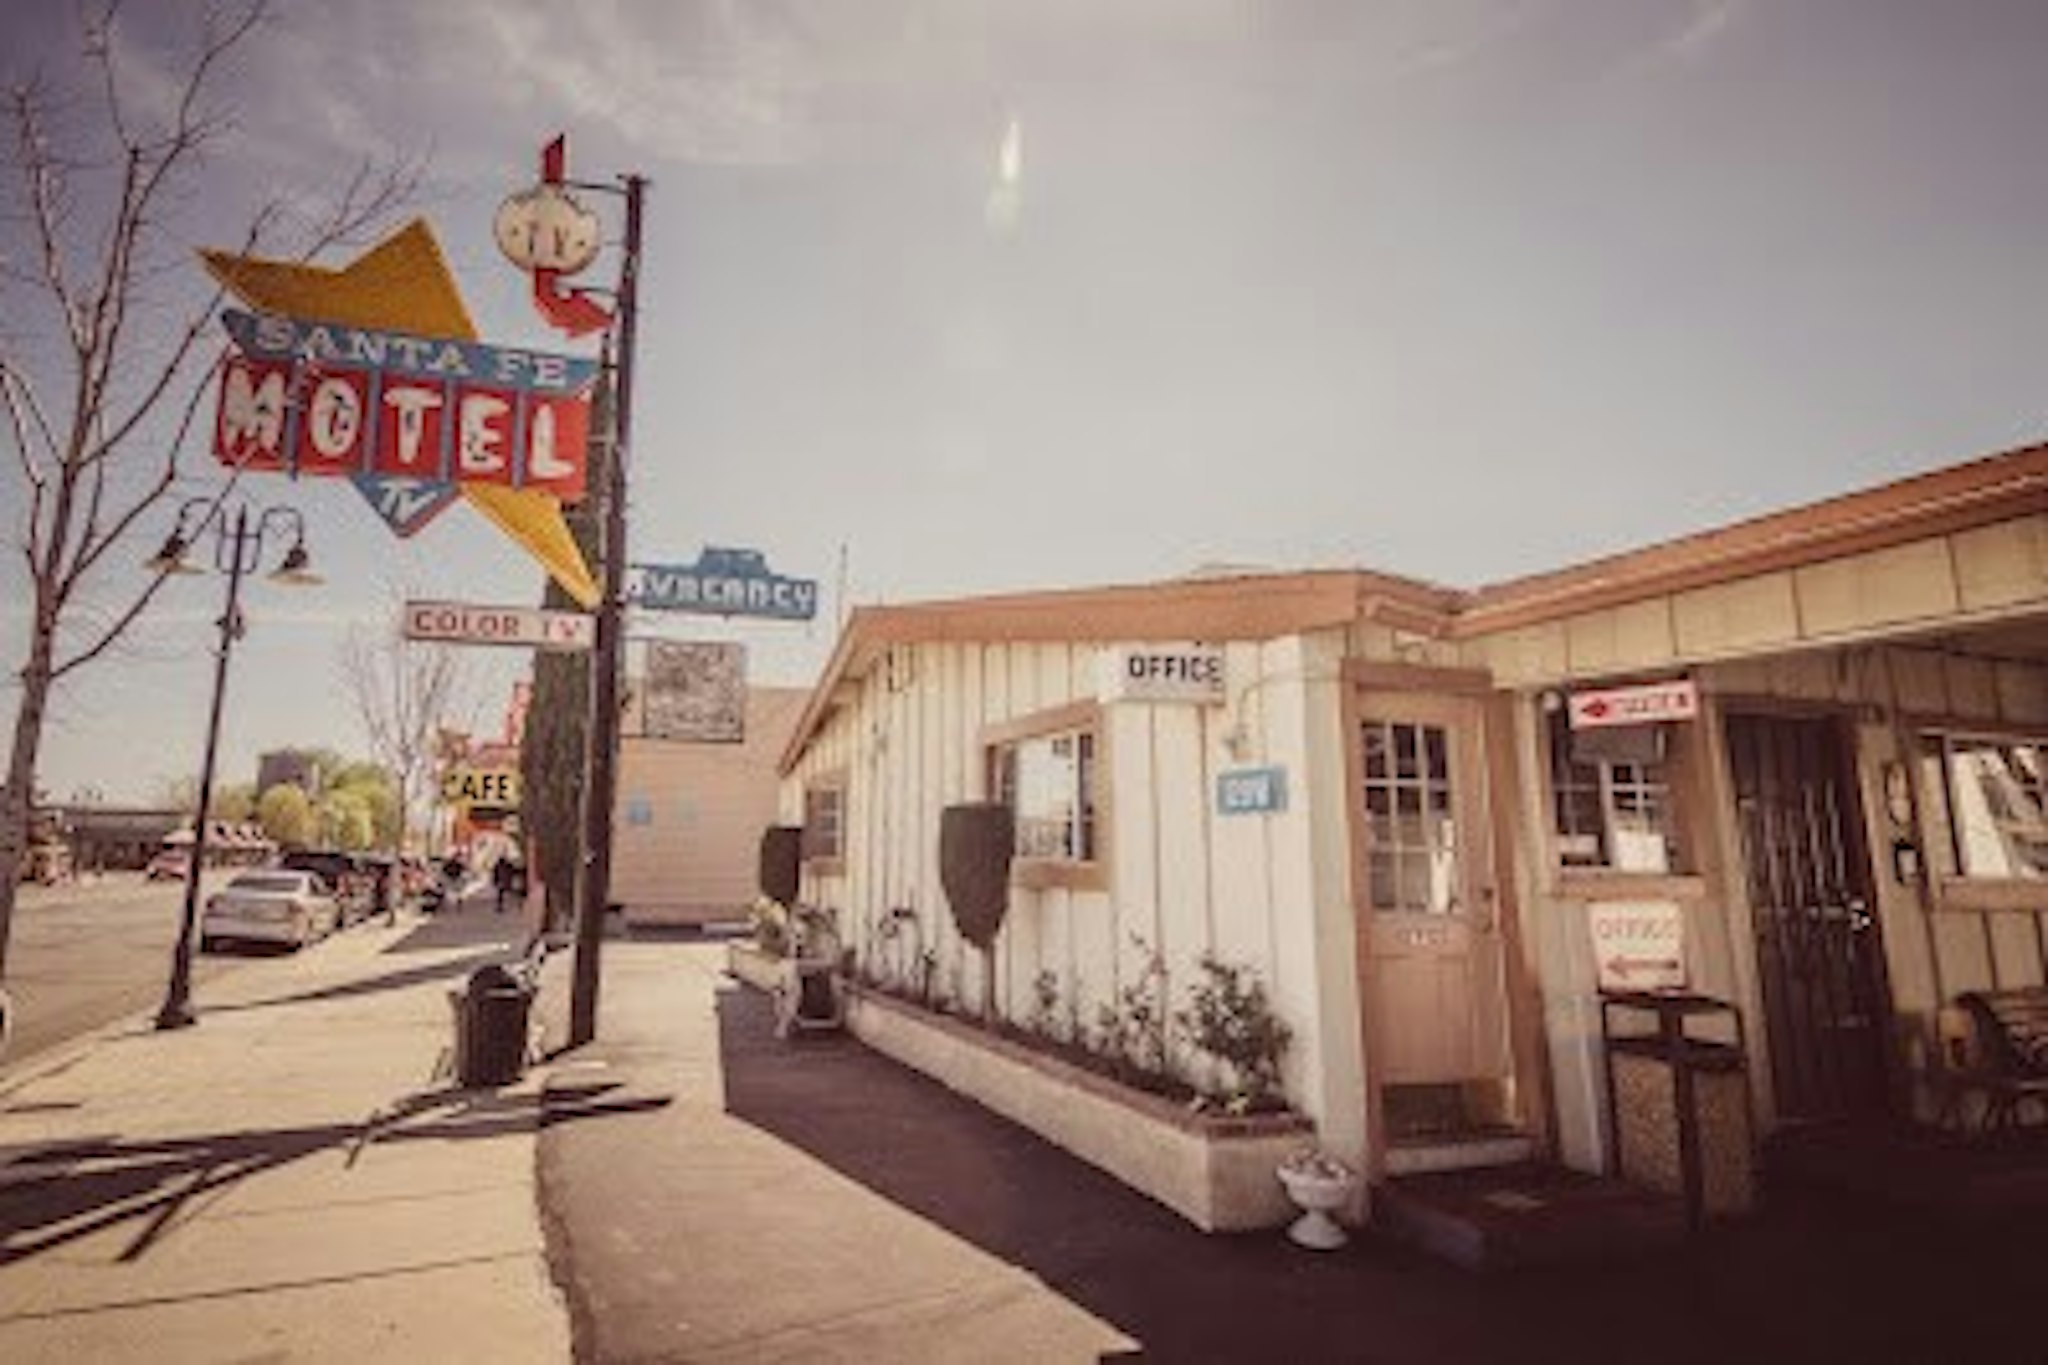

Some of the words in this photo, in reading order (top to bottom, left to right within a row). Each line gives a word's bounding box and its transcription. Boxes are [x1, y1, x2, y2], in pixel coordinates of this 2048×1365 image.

[256, 315, 472, 376] SANTA
[496, 352, 568, 386] FE
[221, 367, 575, 478] MOTEL
[379, 480, 438, 524] TV
[415, 610, 519, 637] COLOR
[1128, 656, 1220, 685] OFFICE
[443, 774, 508, 800] CAFE
